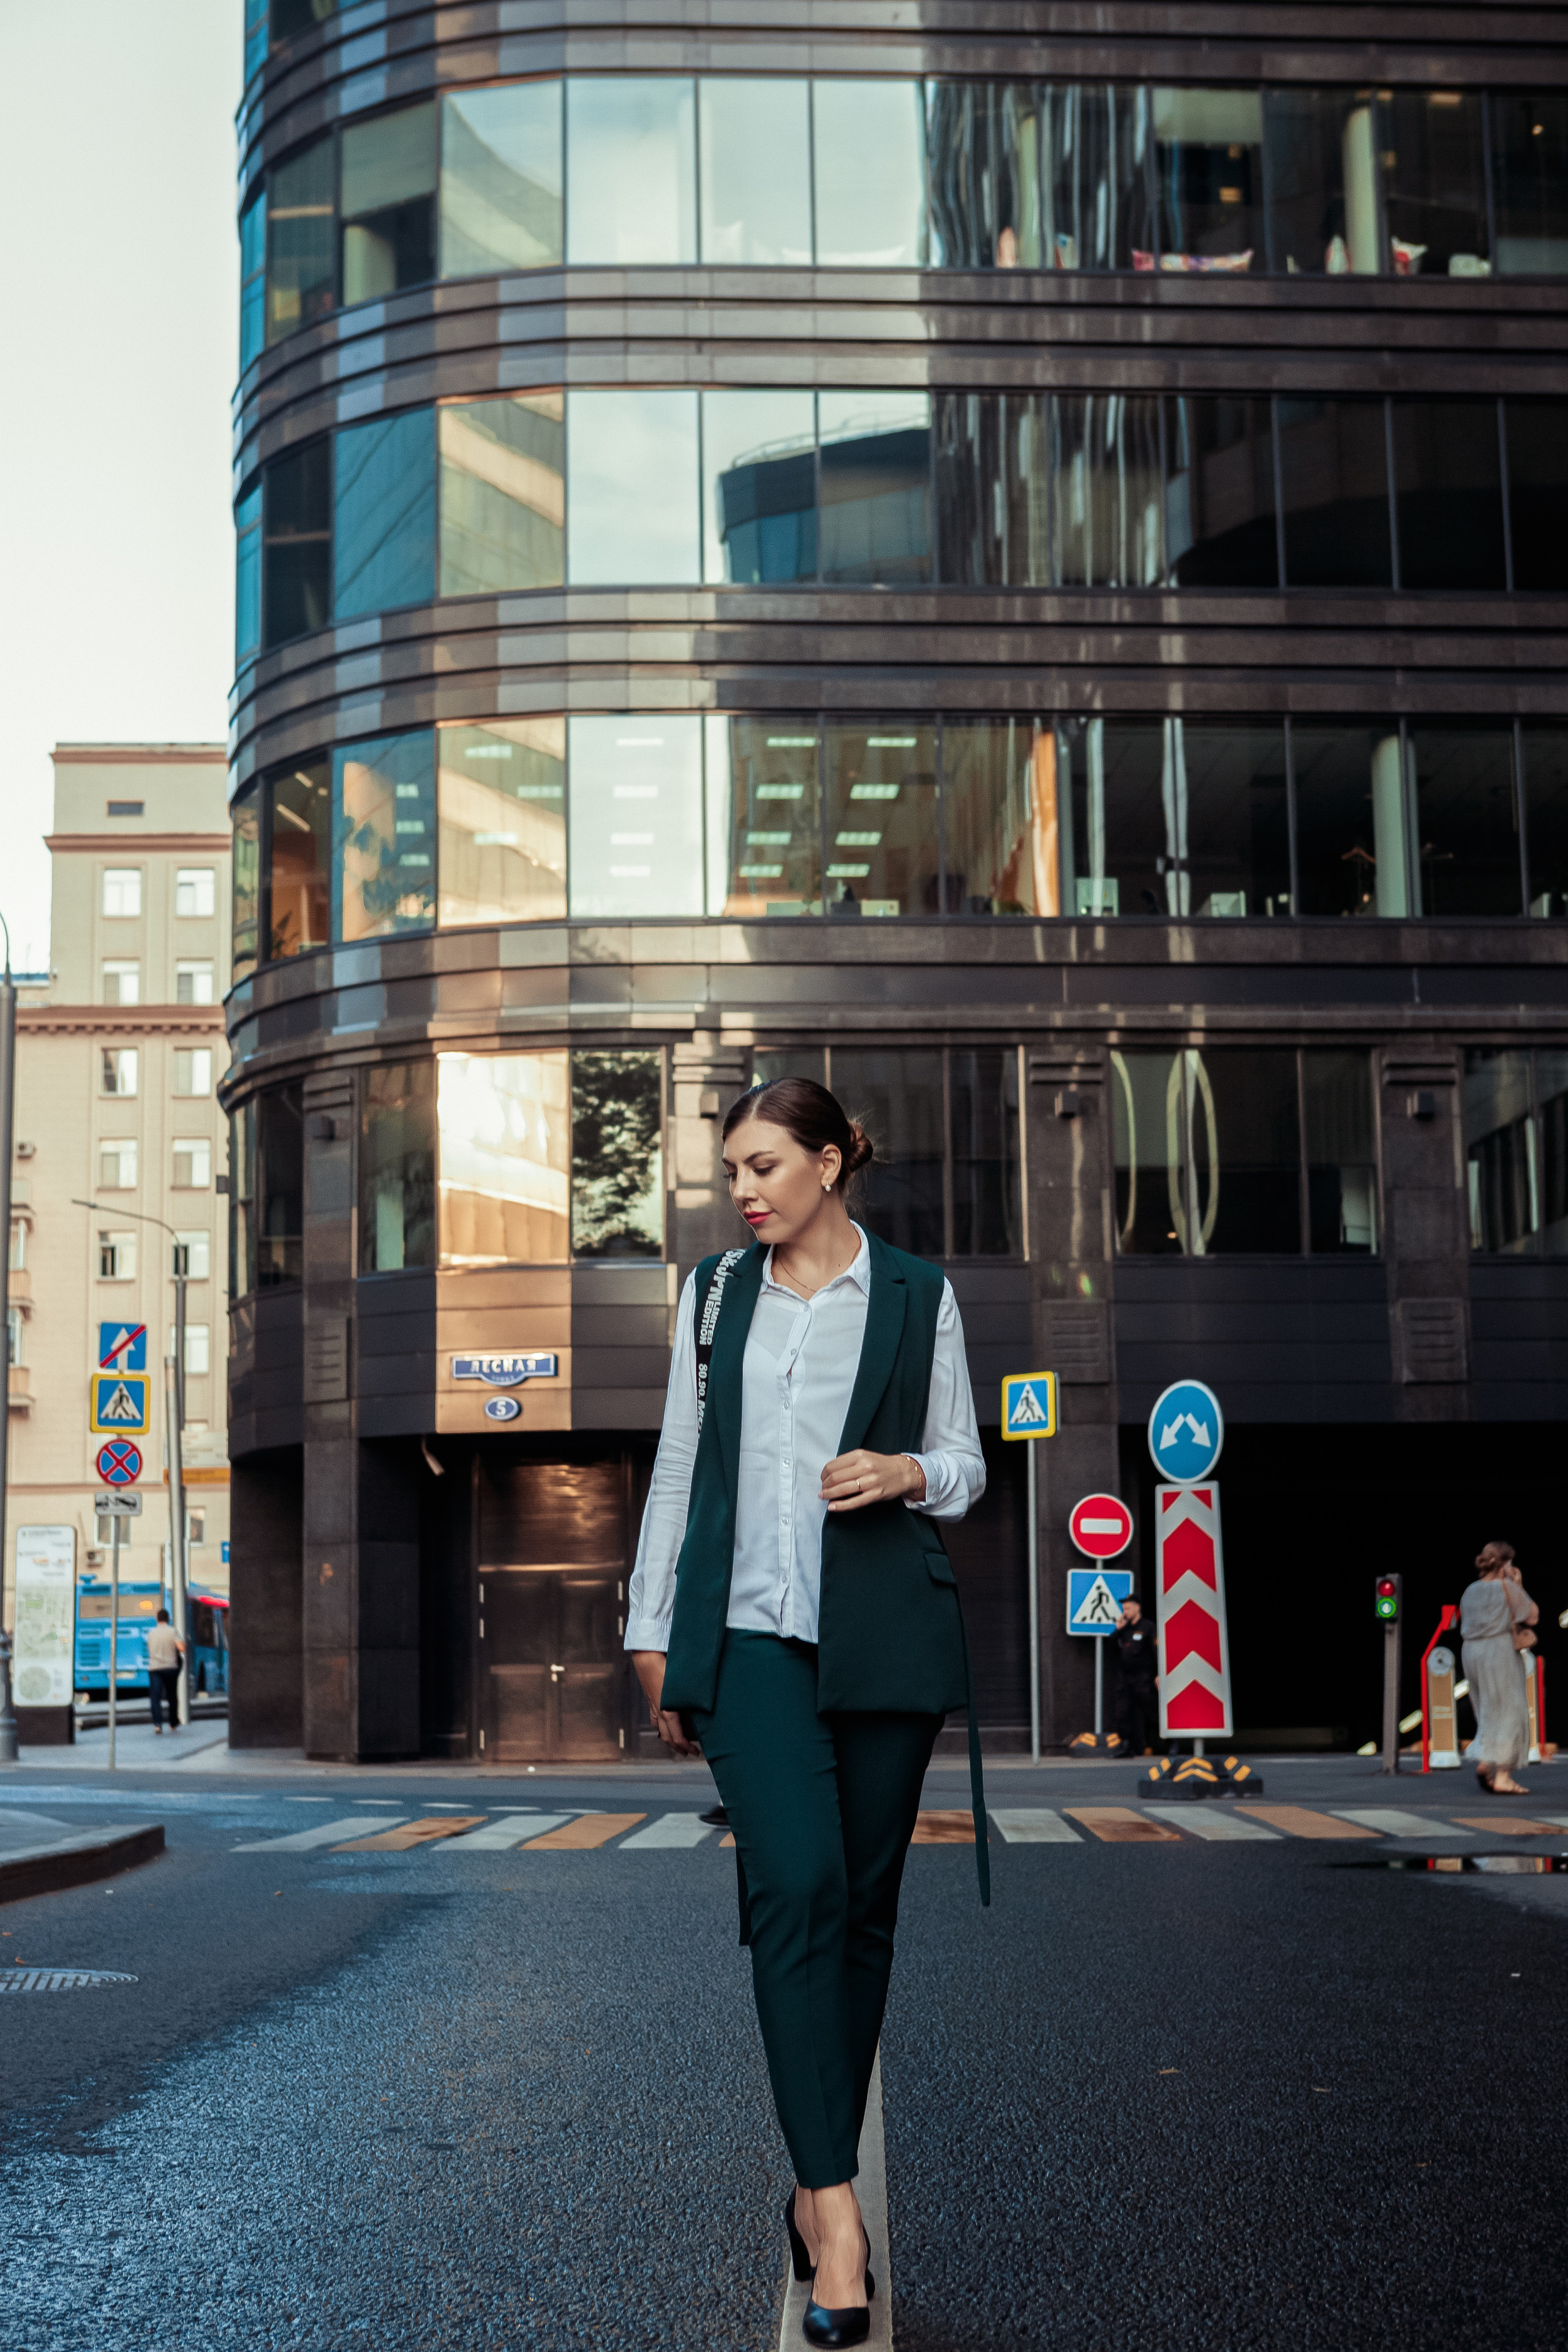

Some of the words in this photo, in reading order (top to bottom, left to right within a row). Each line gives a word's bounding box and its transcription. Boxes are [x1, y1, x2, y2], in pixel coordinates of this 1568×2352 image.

[699, 1299, 714, 1345] EDITION
[707, 1301, 721, 1345] LIMITED
[470, 1359, 537, 1373] ЛЕСНАЯ
[496, 1400, 507, 1417] 5
